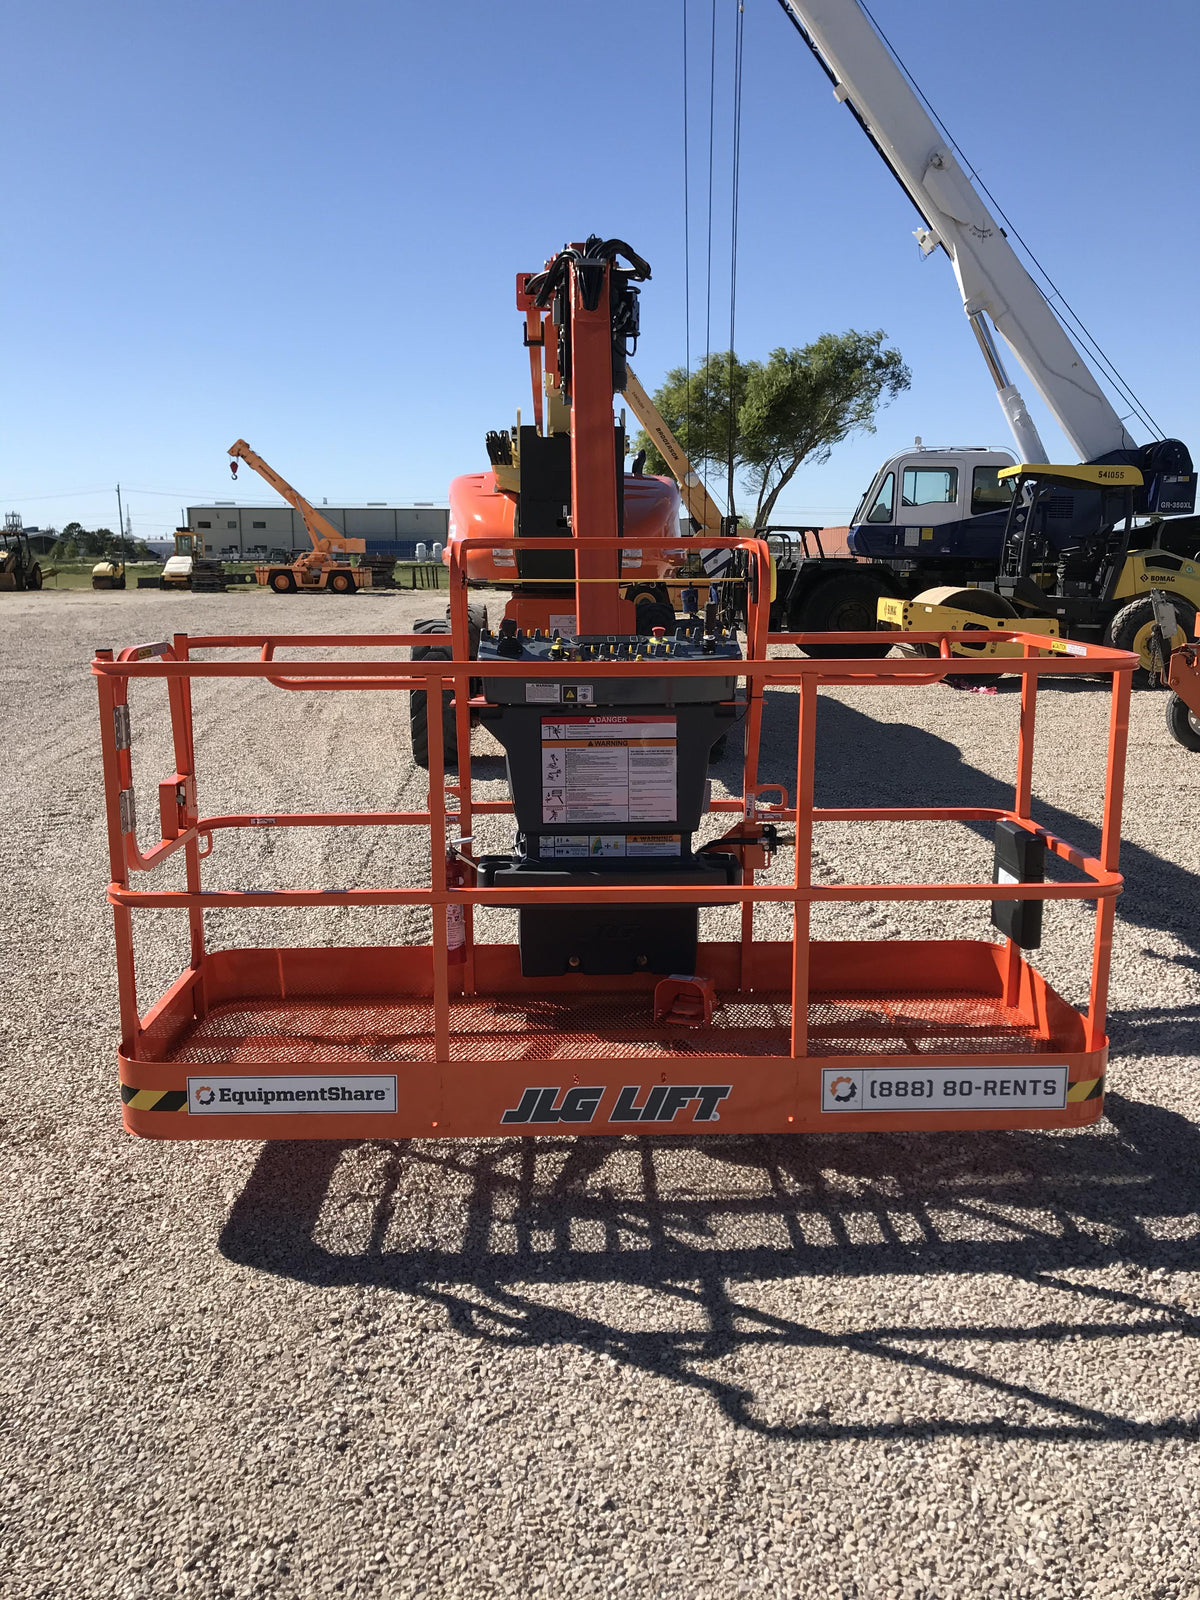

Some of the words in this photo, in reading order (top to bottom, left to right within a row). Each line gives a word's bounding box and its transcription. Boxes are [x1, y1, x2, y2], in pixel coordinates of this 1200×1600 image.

[655, 427, 679, 460] BRODERSON
[1098, 471, 1125, 479] 541055
[1160, 501, 1192, 509] GR-350XL
[218, 1087, 386, 1105] EquipmentShare
[870, 1079, 934, 1098] (888)
[942, 1079, 1057, 1097] 80-RENTS
[500, 1086, 607, 1124] JLG
[608, 1085, 733, 1122] LIFT
